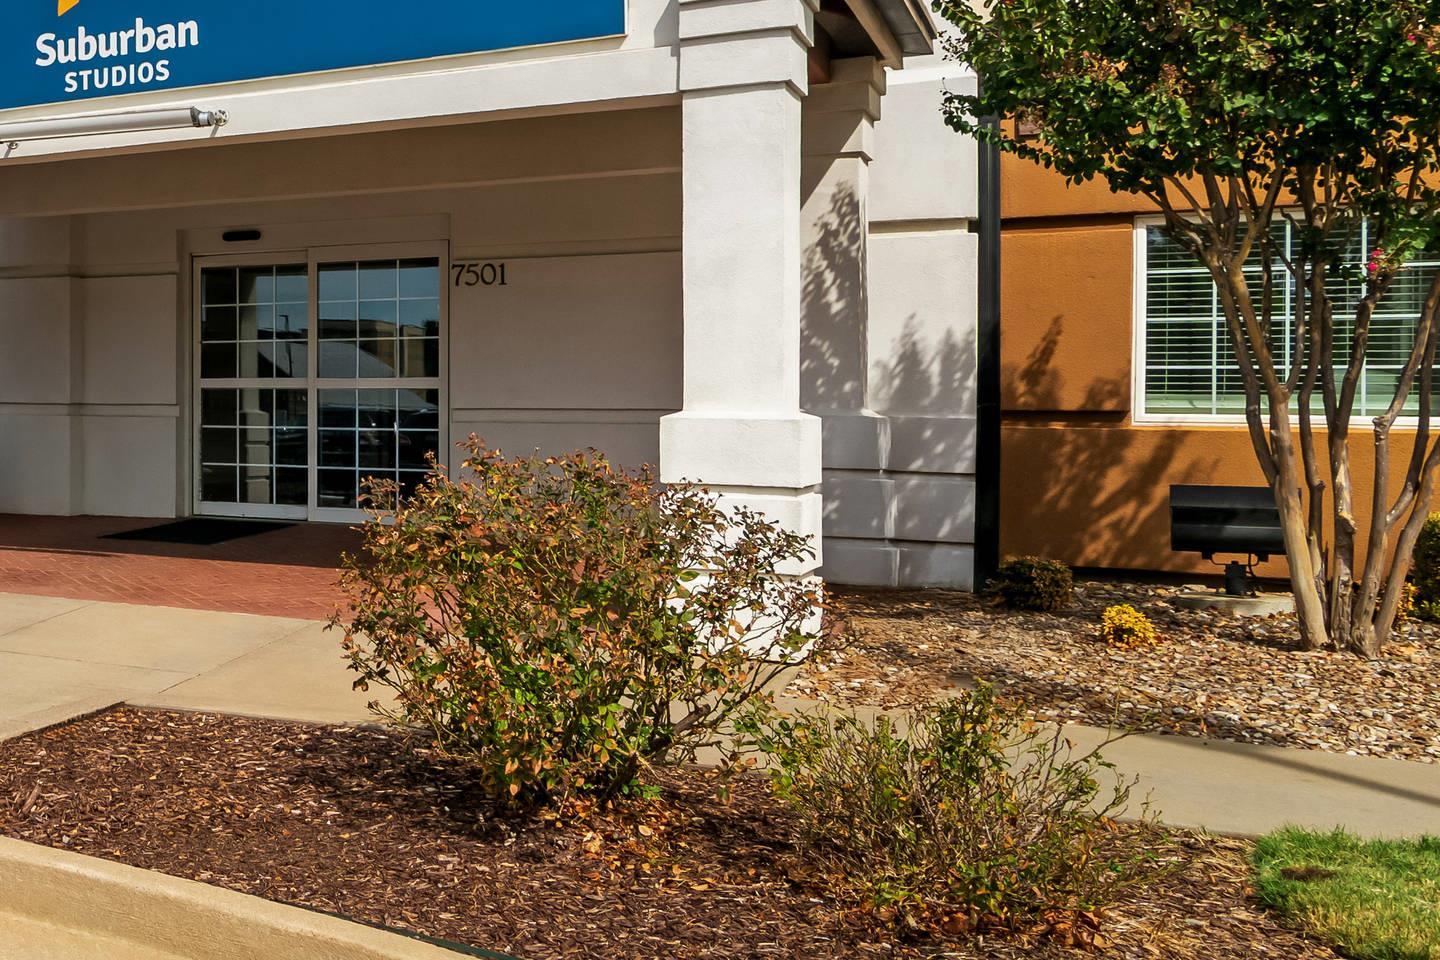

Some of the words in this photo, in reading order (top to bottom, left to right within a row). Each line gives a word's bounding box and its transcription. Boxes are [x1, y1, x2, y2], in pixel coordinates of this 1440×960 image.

[35, 17, 199, 67] Suburban
[64, 60, 170, 93] STUDIOS
[451, 262, 507, 287] 7501
